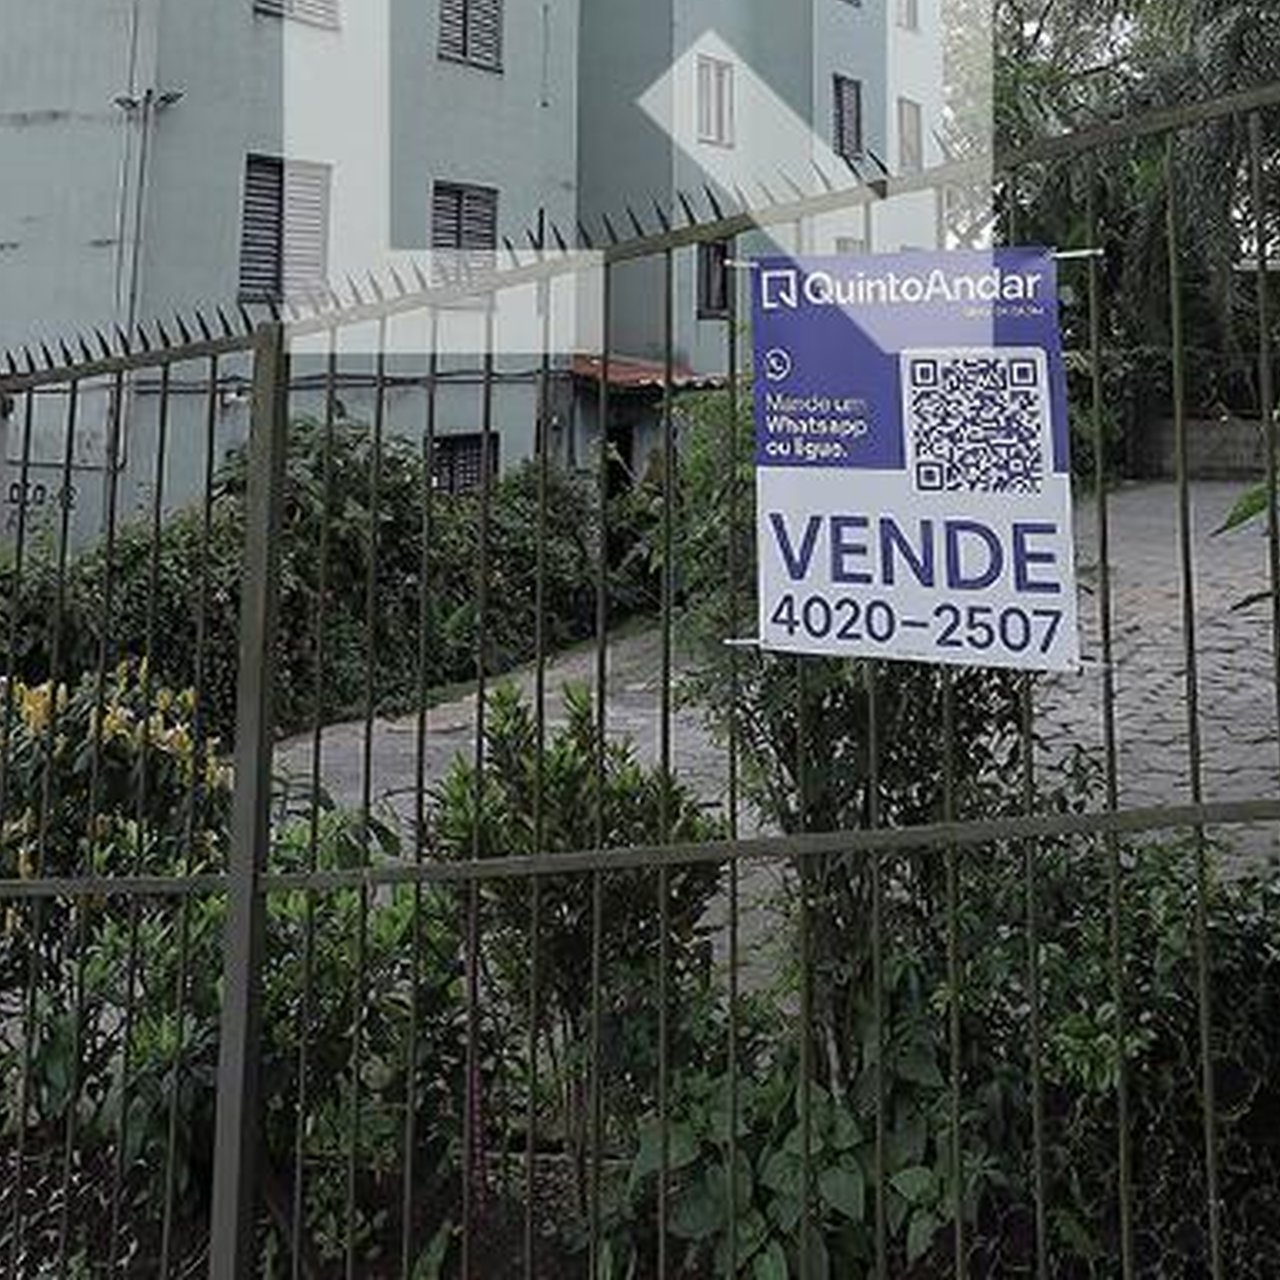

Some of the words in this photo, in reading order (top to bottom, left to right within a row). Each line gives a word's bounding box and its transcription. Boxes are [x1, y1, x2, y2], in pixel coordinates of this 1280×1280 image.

[804, 267, 1041, 304] QuintoAndar
[766, 440, 791, 455] ou
[769, 513, 1062, 593] VENDE
[771, 594, 1064, 654] 4020-2507
